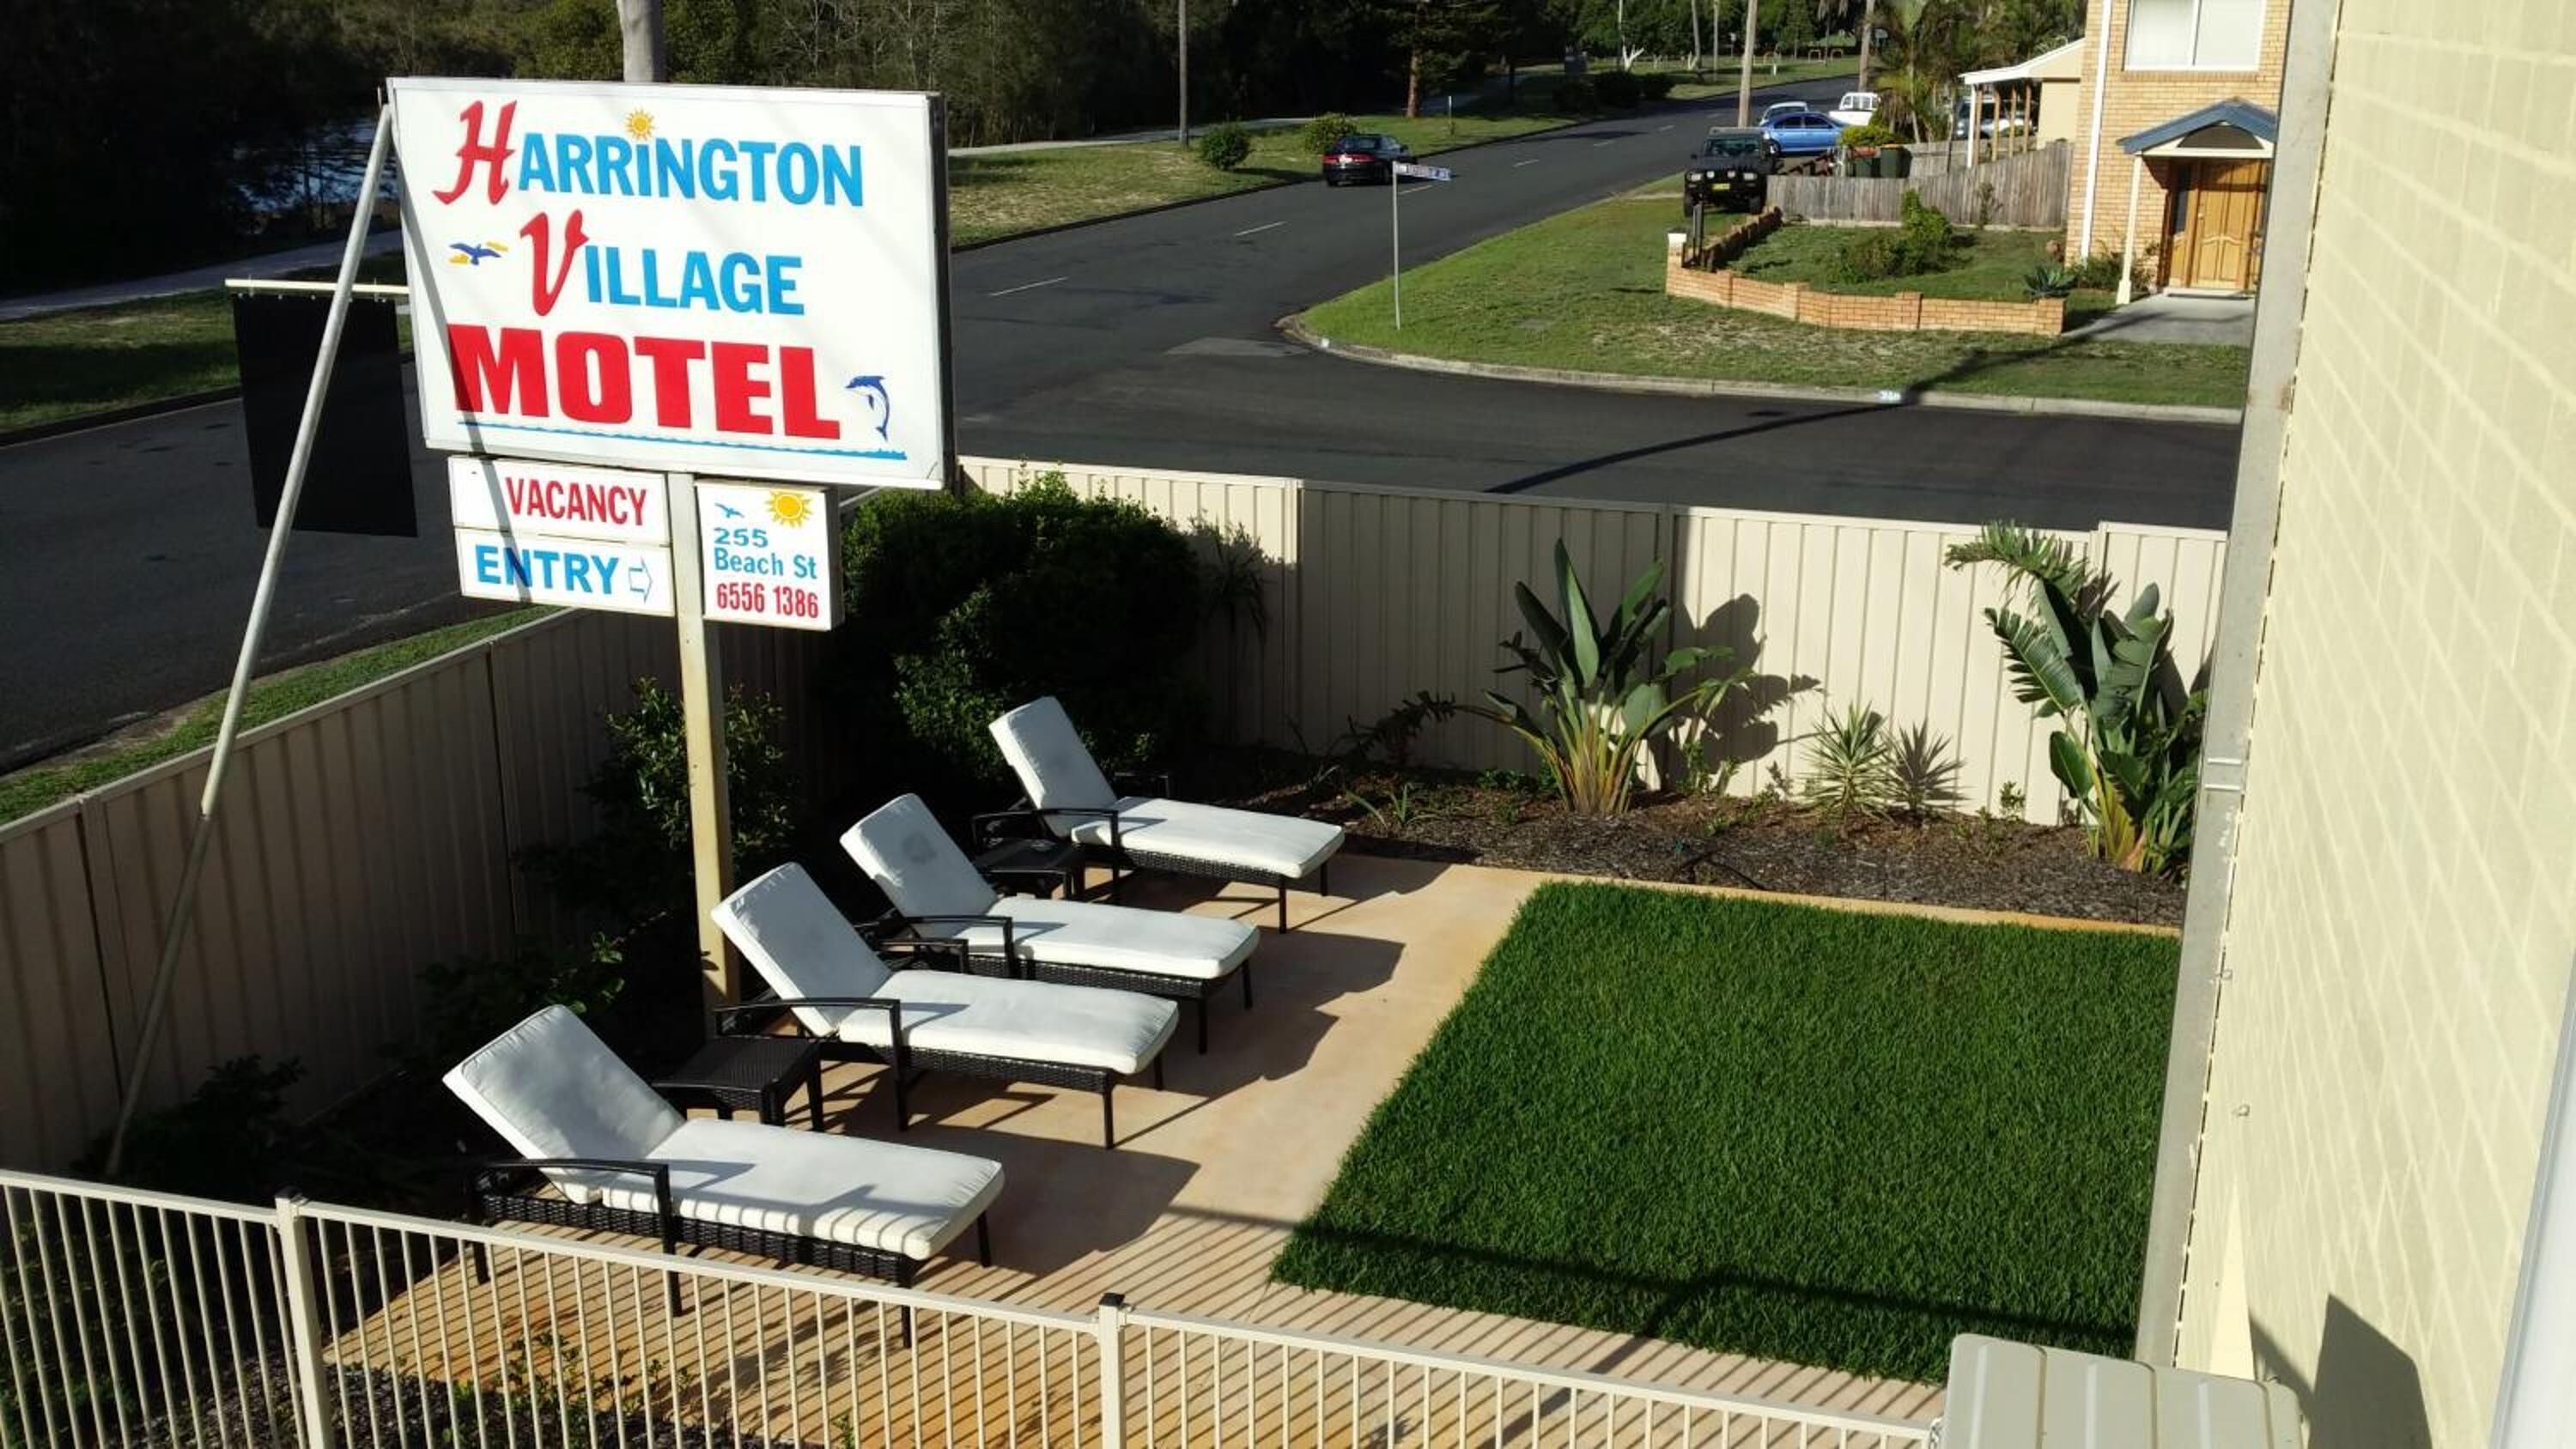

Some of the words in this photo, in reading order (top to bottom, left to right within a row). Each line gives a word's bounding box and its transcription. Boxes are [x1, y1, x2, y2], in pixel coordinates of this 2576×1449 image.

[432, 100, 863, 206] HARRINGTON
[519, 209, 805, 317] VILLAGE
[447, 324, 841, 440] MOTEL
[506, 476, 647, 525] VACANCY
[714, 527, 769, 548] 255
[475, 544, 619, 595] ENTRY
[714, 548, 784, 576] Beach
[793, 555, 817, 579] St
[716, 583, 765, 614] 6556
[772, 586, 819, 618] 1386
